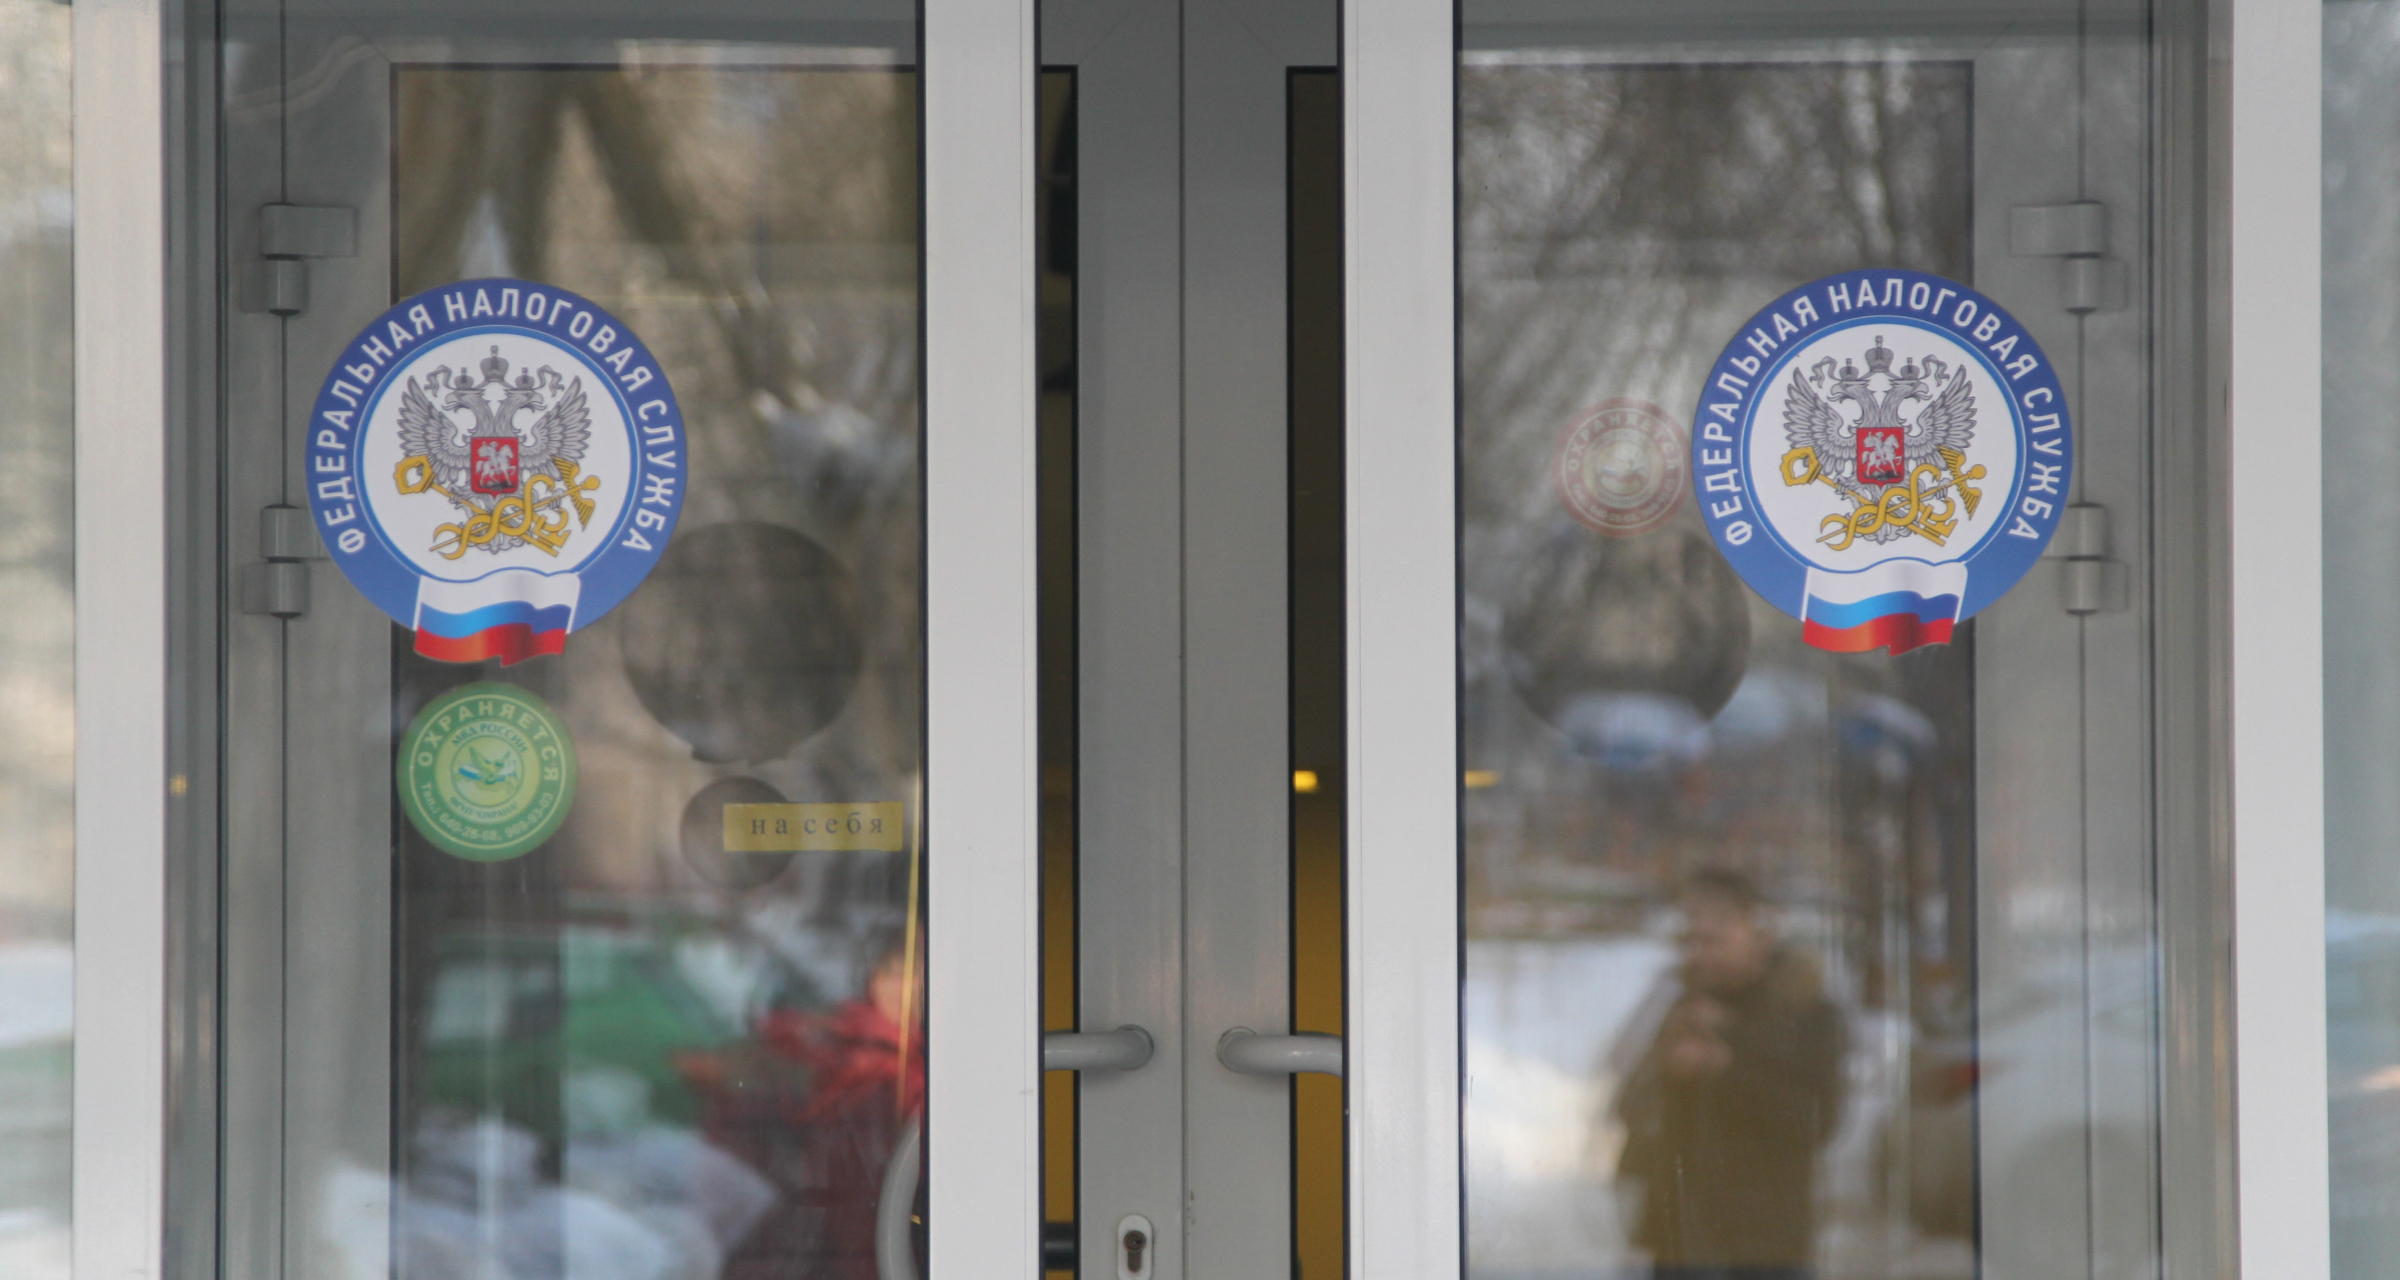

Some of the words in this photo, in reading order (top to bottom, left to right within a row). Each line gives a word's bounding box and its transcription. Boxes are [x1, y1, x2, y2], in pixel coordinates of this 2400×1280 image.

[316, 303, 435, 554] ФЕДЕРАЛЬНАЯ
[443, 288, 654, 392] НАЛОГОВАЯ
[621, 399, 677, 553] СЛУЖБА
[1703, 296, 1820, 546] ФЕДЕРАЛЬНАЯ
[1828, 278, 2038, 381] НАЛОГОВАЯ
[2008, 387, 2063, 541] СЛУЖБА
[417, 700, 559, 782] ОХРАНЯЕТСЯ
[480, 723, 528, 752] РОССИИ
[751, 817, 789, 835] на
[804, 811, 884, 835] себя
